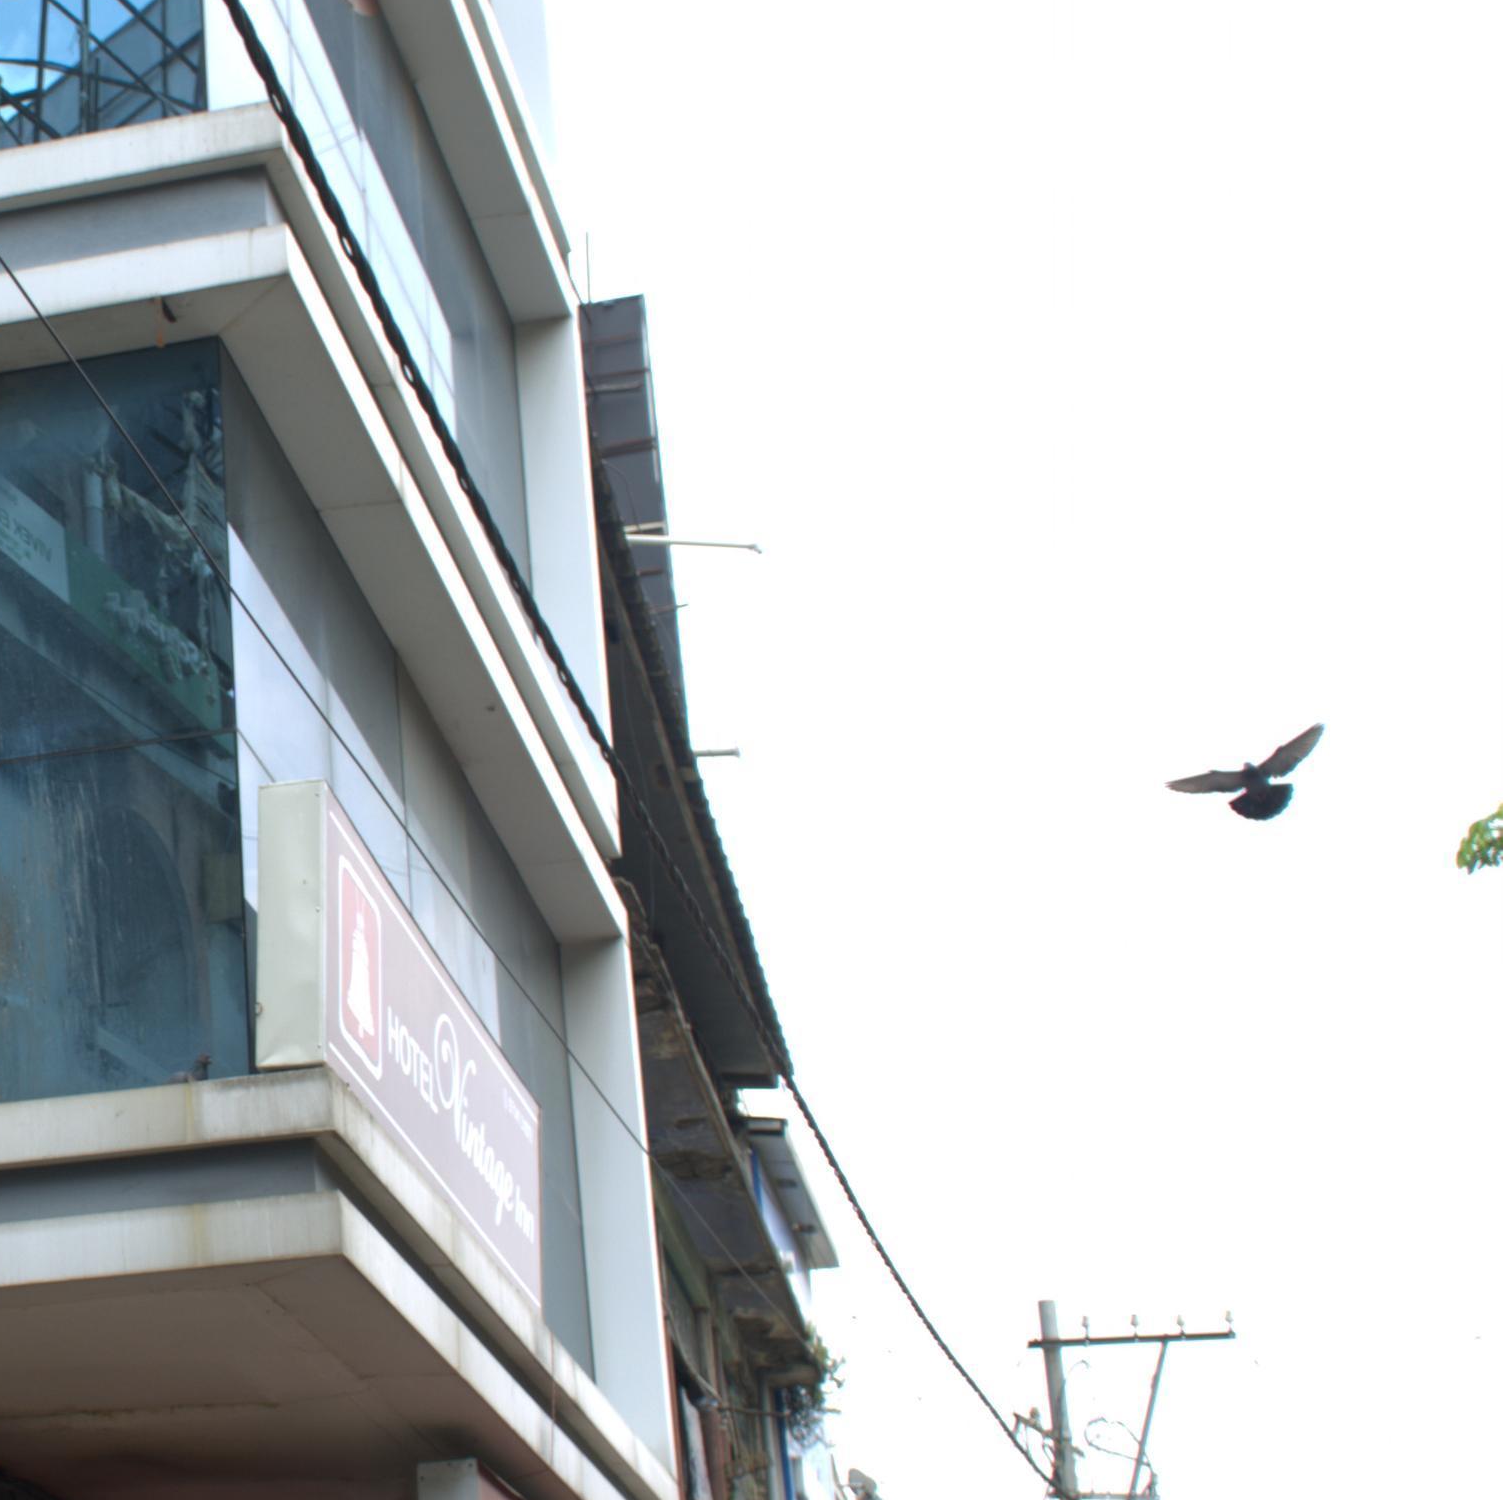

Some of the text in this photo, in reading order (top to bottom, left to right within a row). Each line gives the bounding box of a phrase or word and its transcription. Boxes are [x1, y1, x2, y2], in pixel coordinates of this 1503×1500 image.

[387, 1005, 438, 1114] HOTEL
[434, 1013, 514, 1227] Vintage
[515, 1184, 535, 1244] Inn
